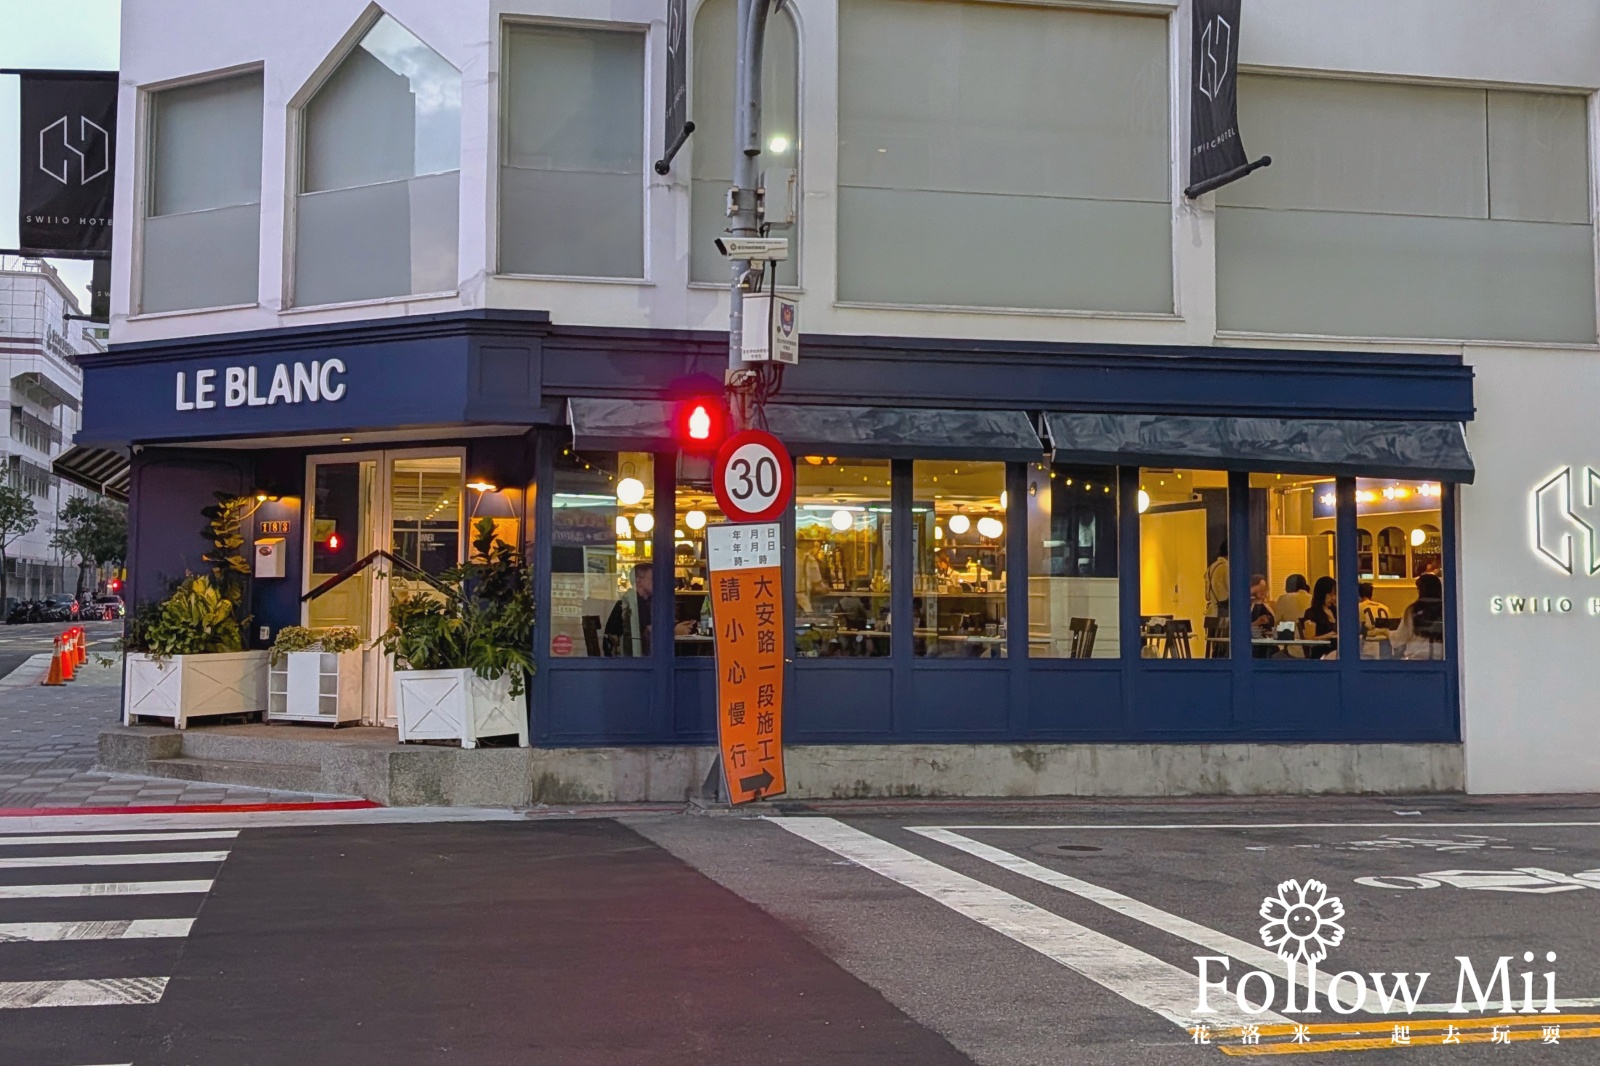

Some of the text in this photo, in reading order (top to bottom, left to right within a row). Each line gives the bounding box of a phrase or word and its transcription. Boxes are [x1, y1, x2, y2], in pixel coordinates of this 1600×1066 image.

[26, 215, 70, 225] SWIIO
[176, 358, 347, 411] LE BLANC
[731, 456, 778, 500] 30
[1491, 597, 1573, 613] SWIIO
[719, 576, 747, 769] 請小心慢行
[753, 574, 776, 763] 大安路一段施工
